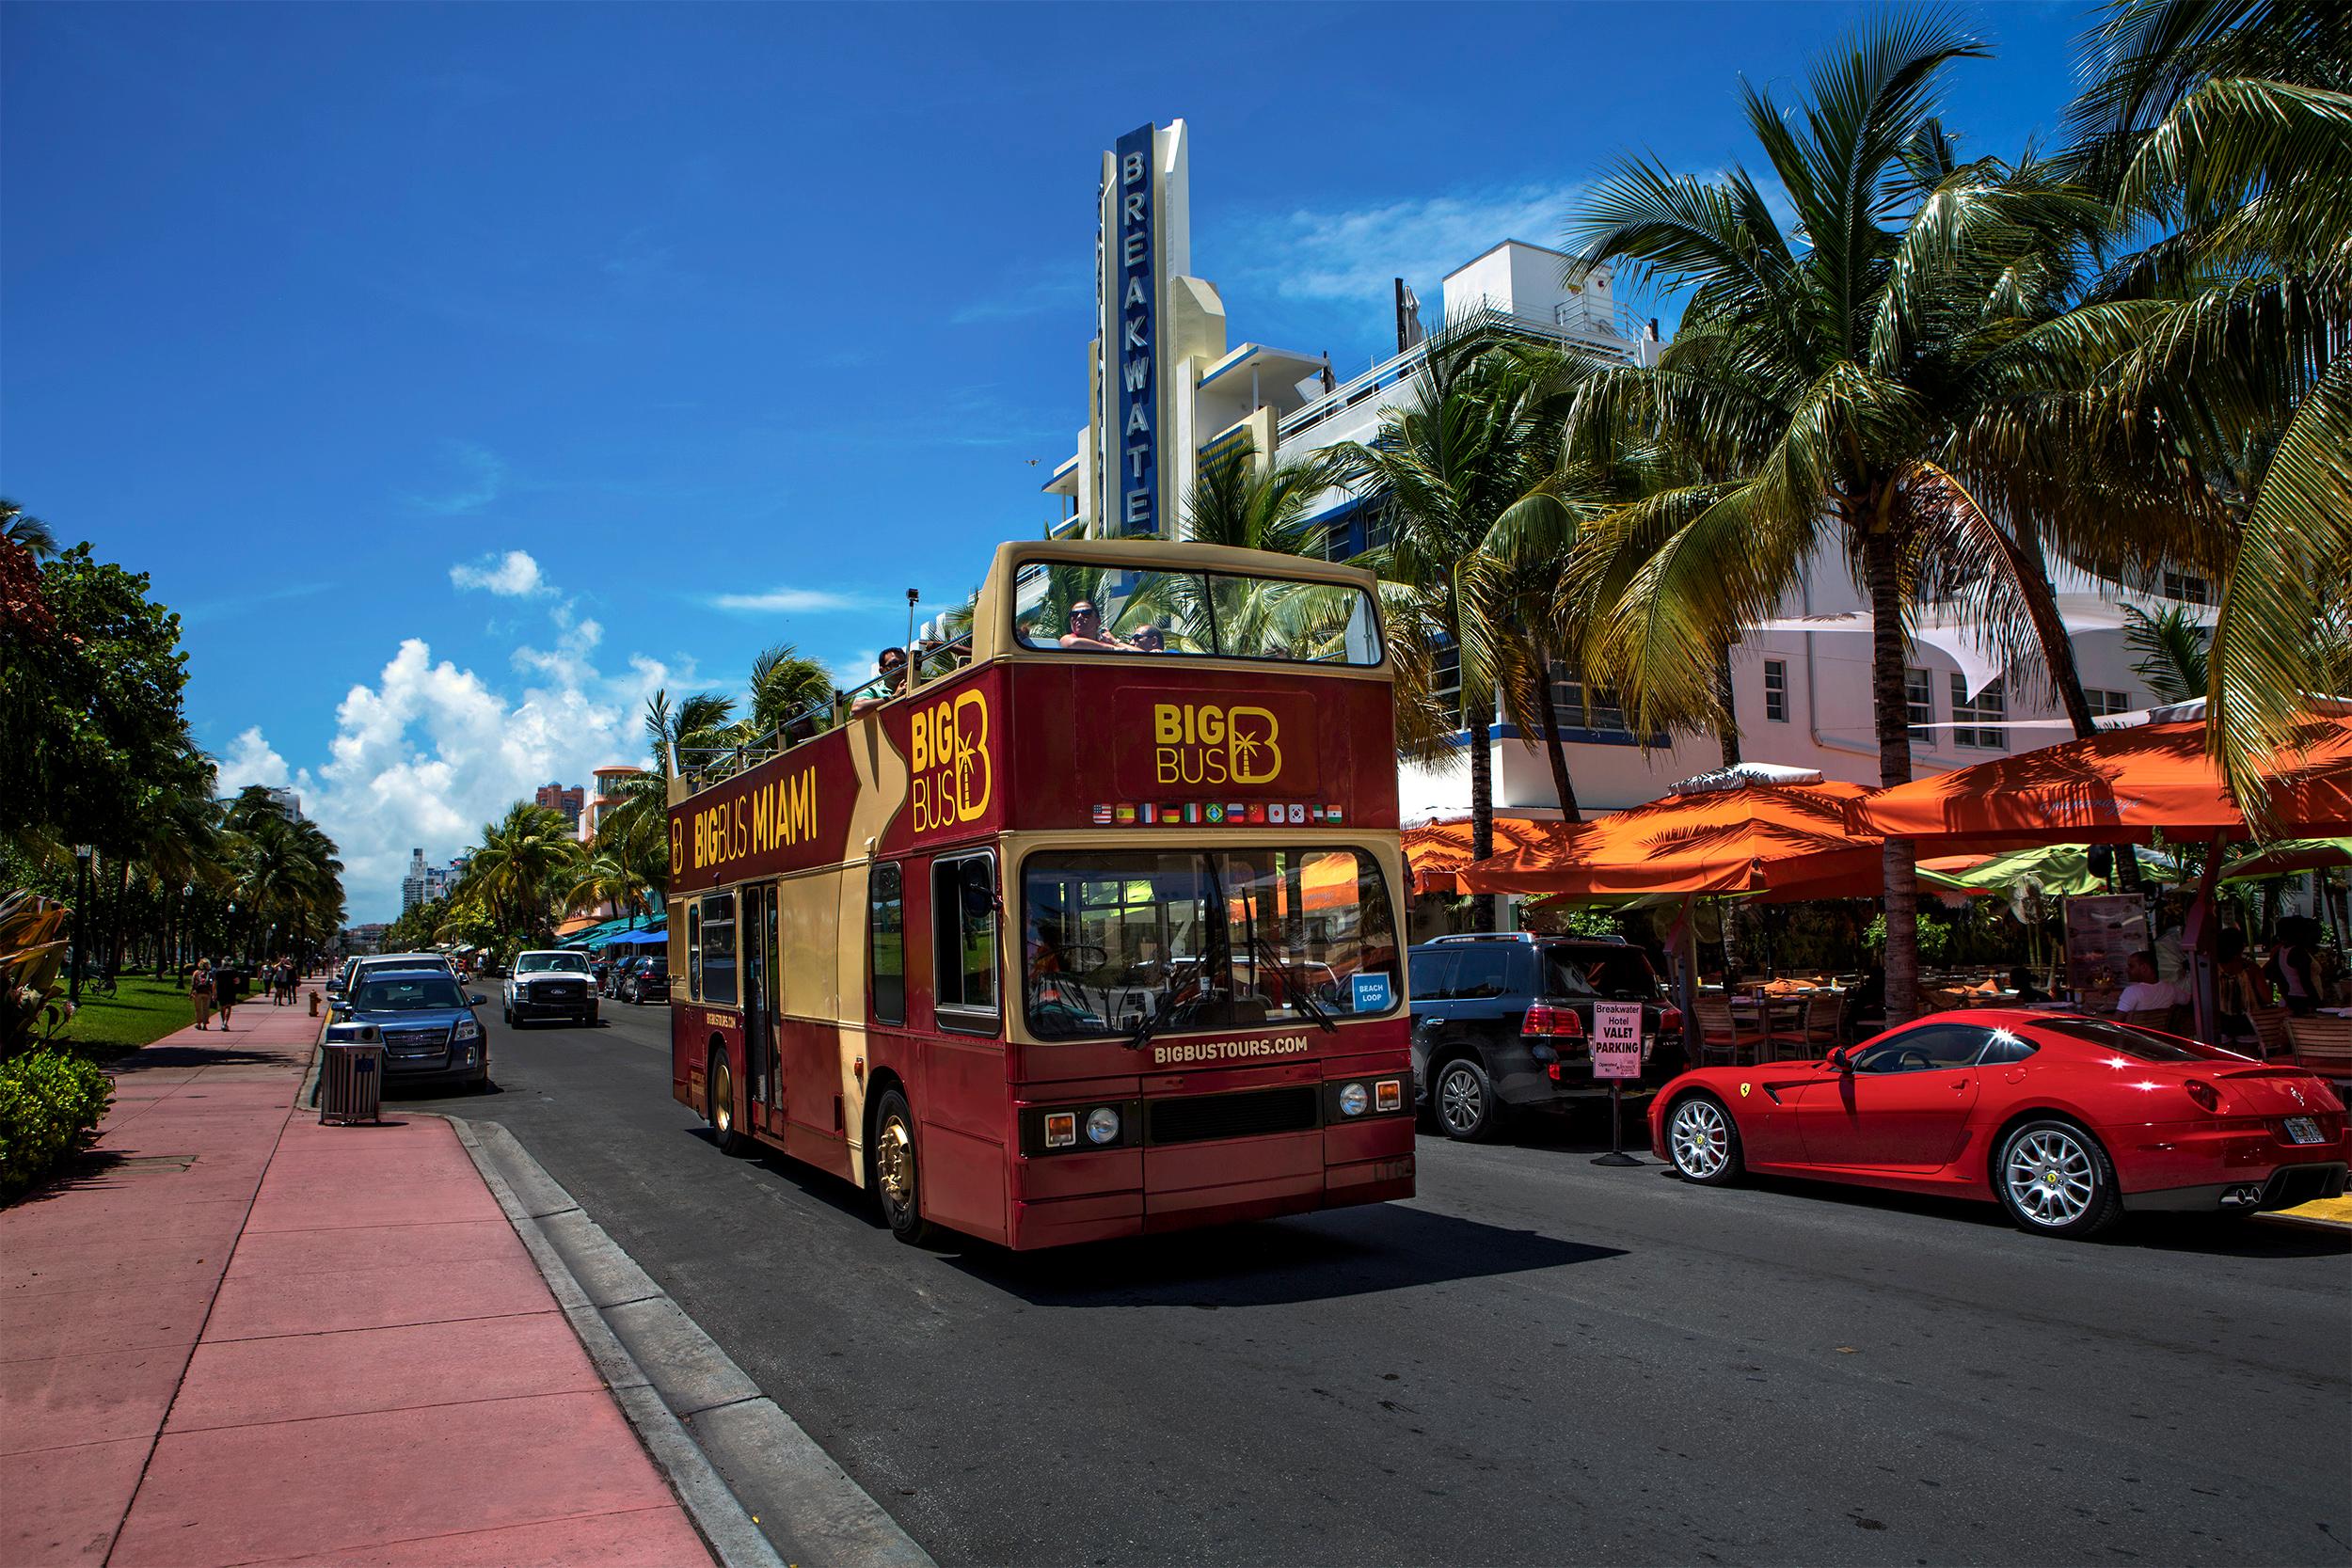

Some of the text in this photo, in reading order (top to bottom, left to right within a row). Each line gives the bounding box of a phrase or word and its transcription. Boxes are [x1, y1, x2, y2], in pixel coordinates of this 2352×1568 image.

[1154, 704, 1225, 745] BIG
[912, 701, 953, 774] BIG
[1156, 748, 1227, 784] BUS
[753, 765, 817, 855] MIAMI
[913, 768, 956, 832] BUS
[1359, 984, 1384, 993] BEACH
[1362, 993, 1382, 1002] LOOP
[1596, 1005, 1640, 1014] Breakwater
[1608, 1017, 1629, 1025] Hotel
[1603, 1027, 1633, 1038] VALET
[1154, 1036, 1308, 1064] BIGBUSTOURS.COM
[1596, 1041, 1639, 1053] PARKING
